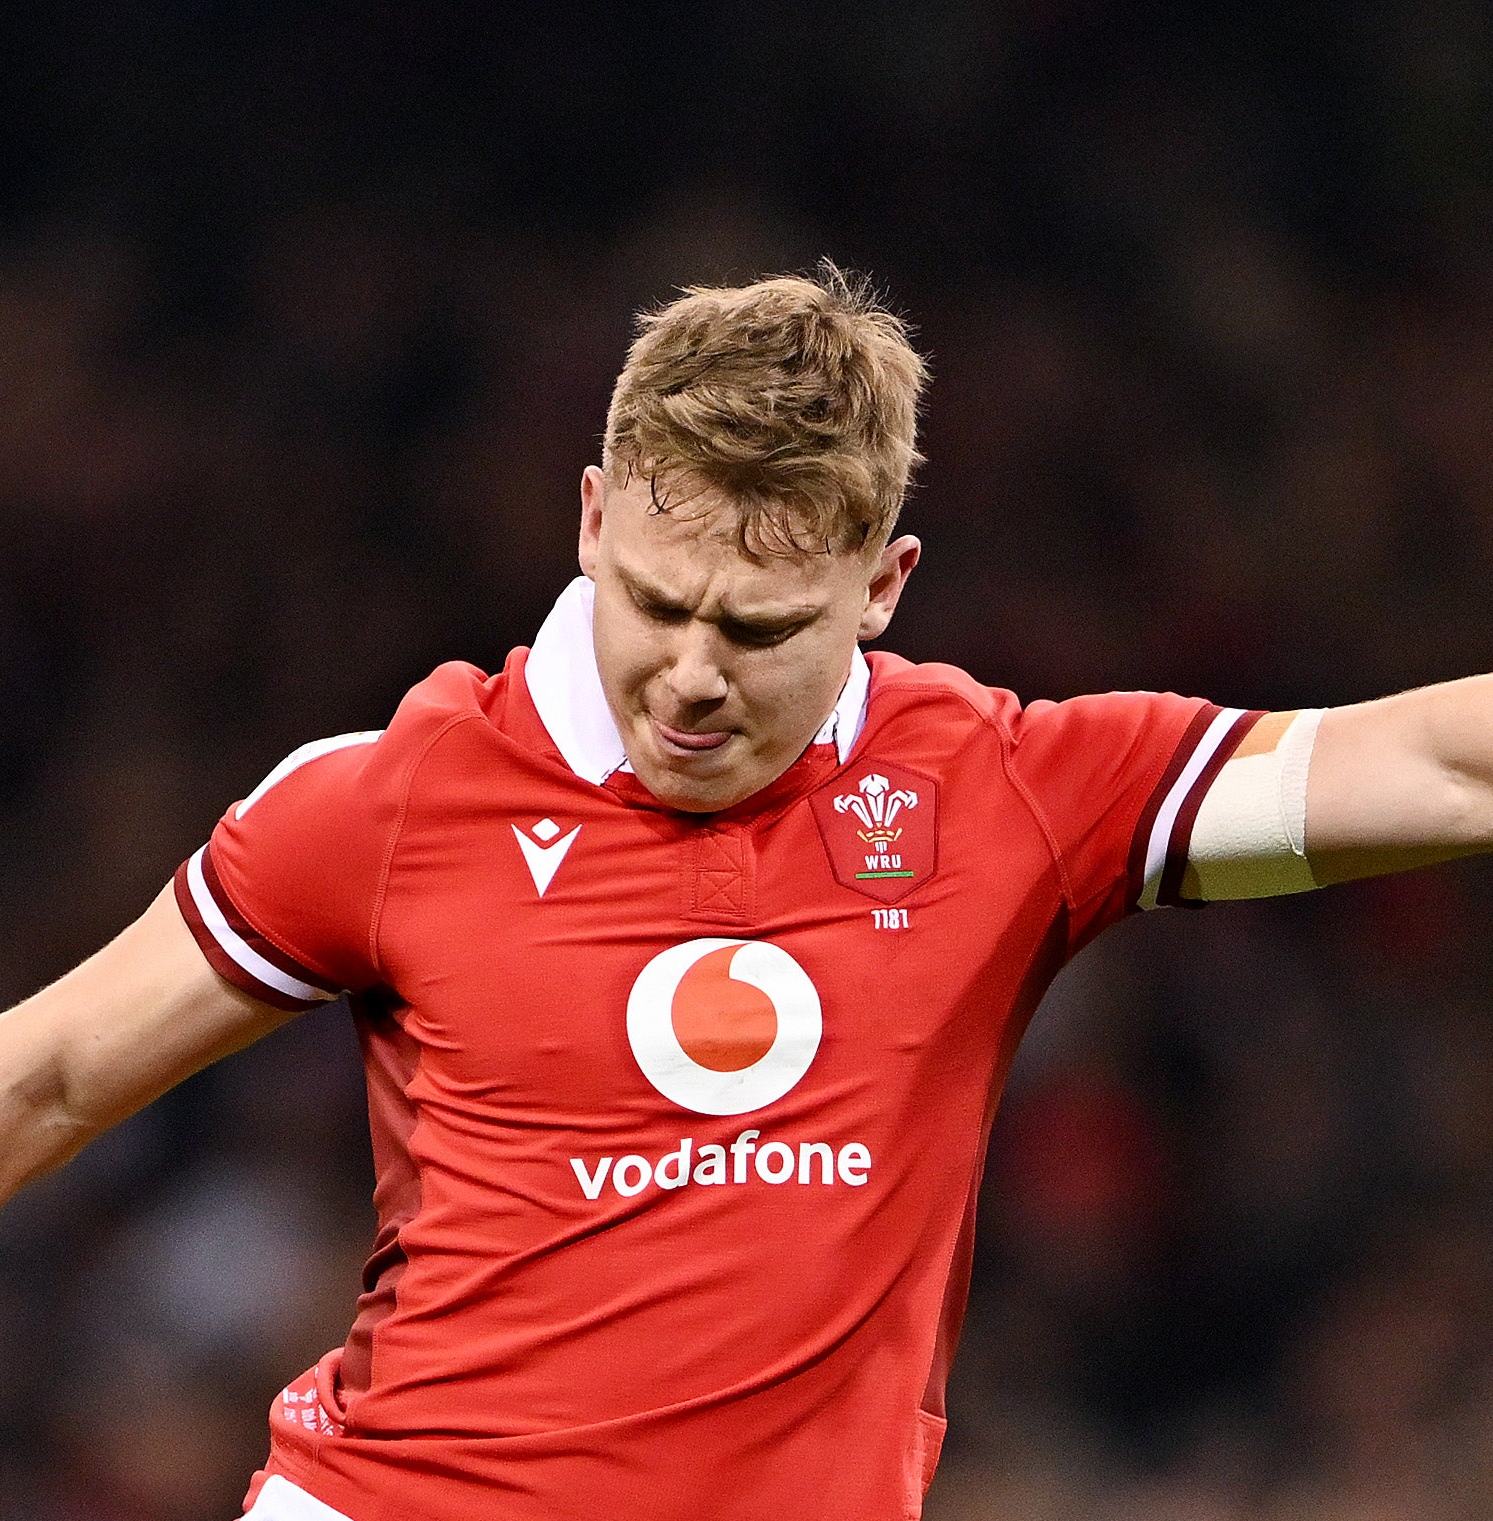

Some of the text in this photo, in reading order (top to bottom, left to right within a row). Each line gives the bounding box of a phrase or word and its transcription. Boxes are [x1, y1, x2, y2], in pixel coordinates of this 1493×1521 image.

[865, 855, 901, 869] WRU
[871, 909, 909, 929] 1181
[571, 1130, 871, 1199] vodafone
